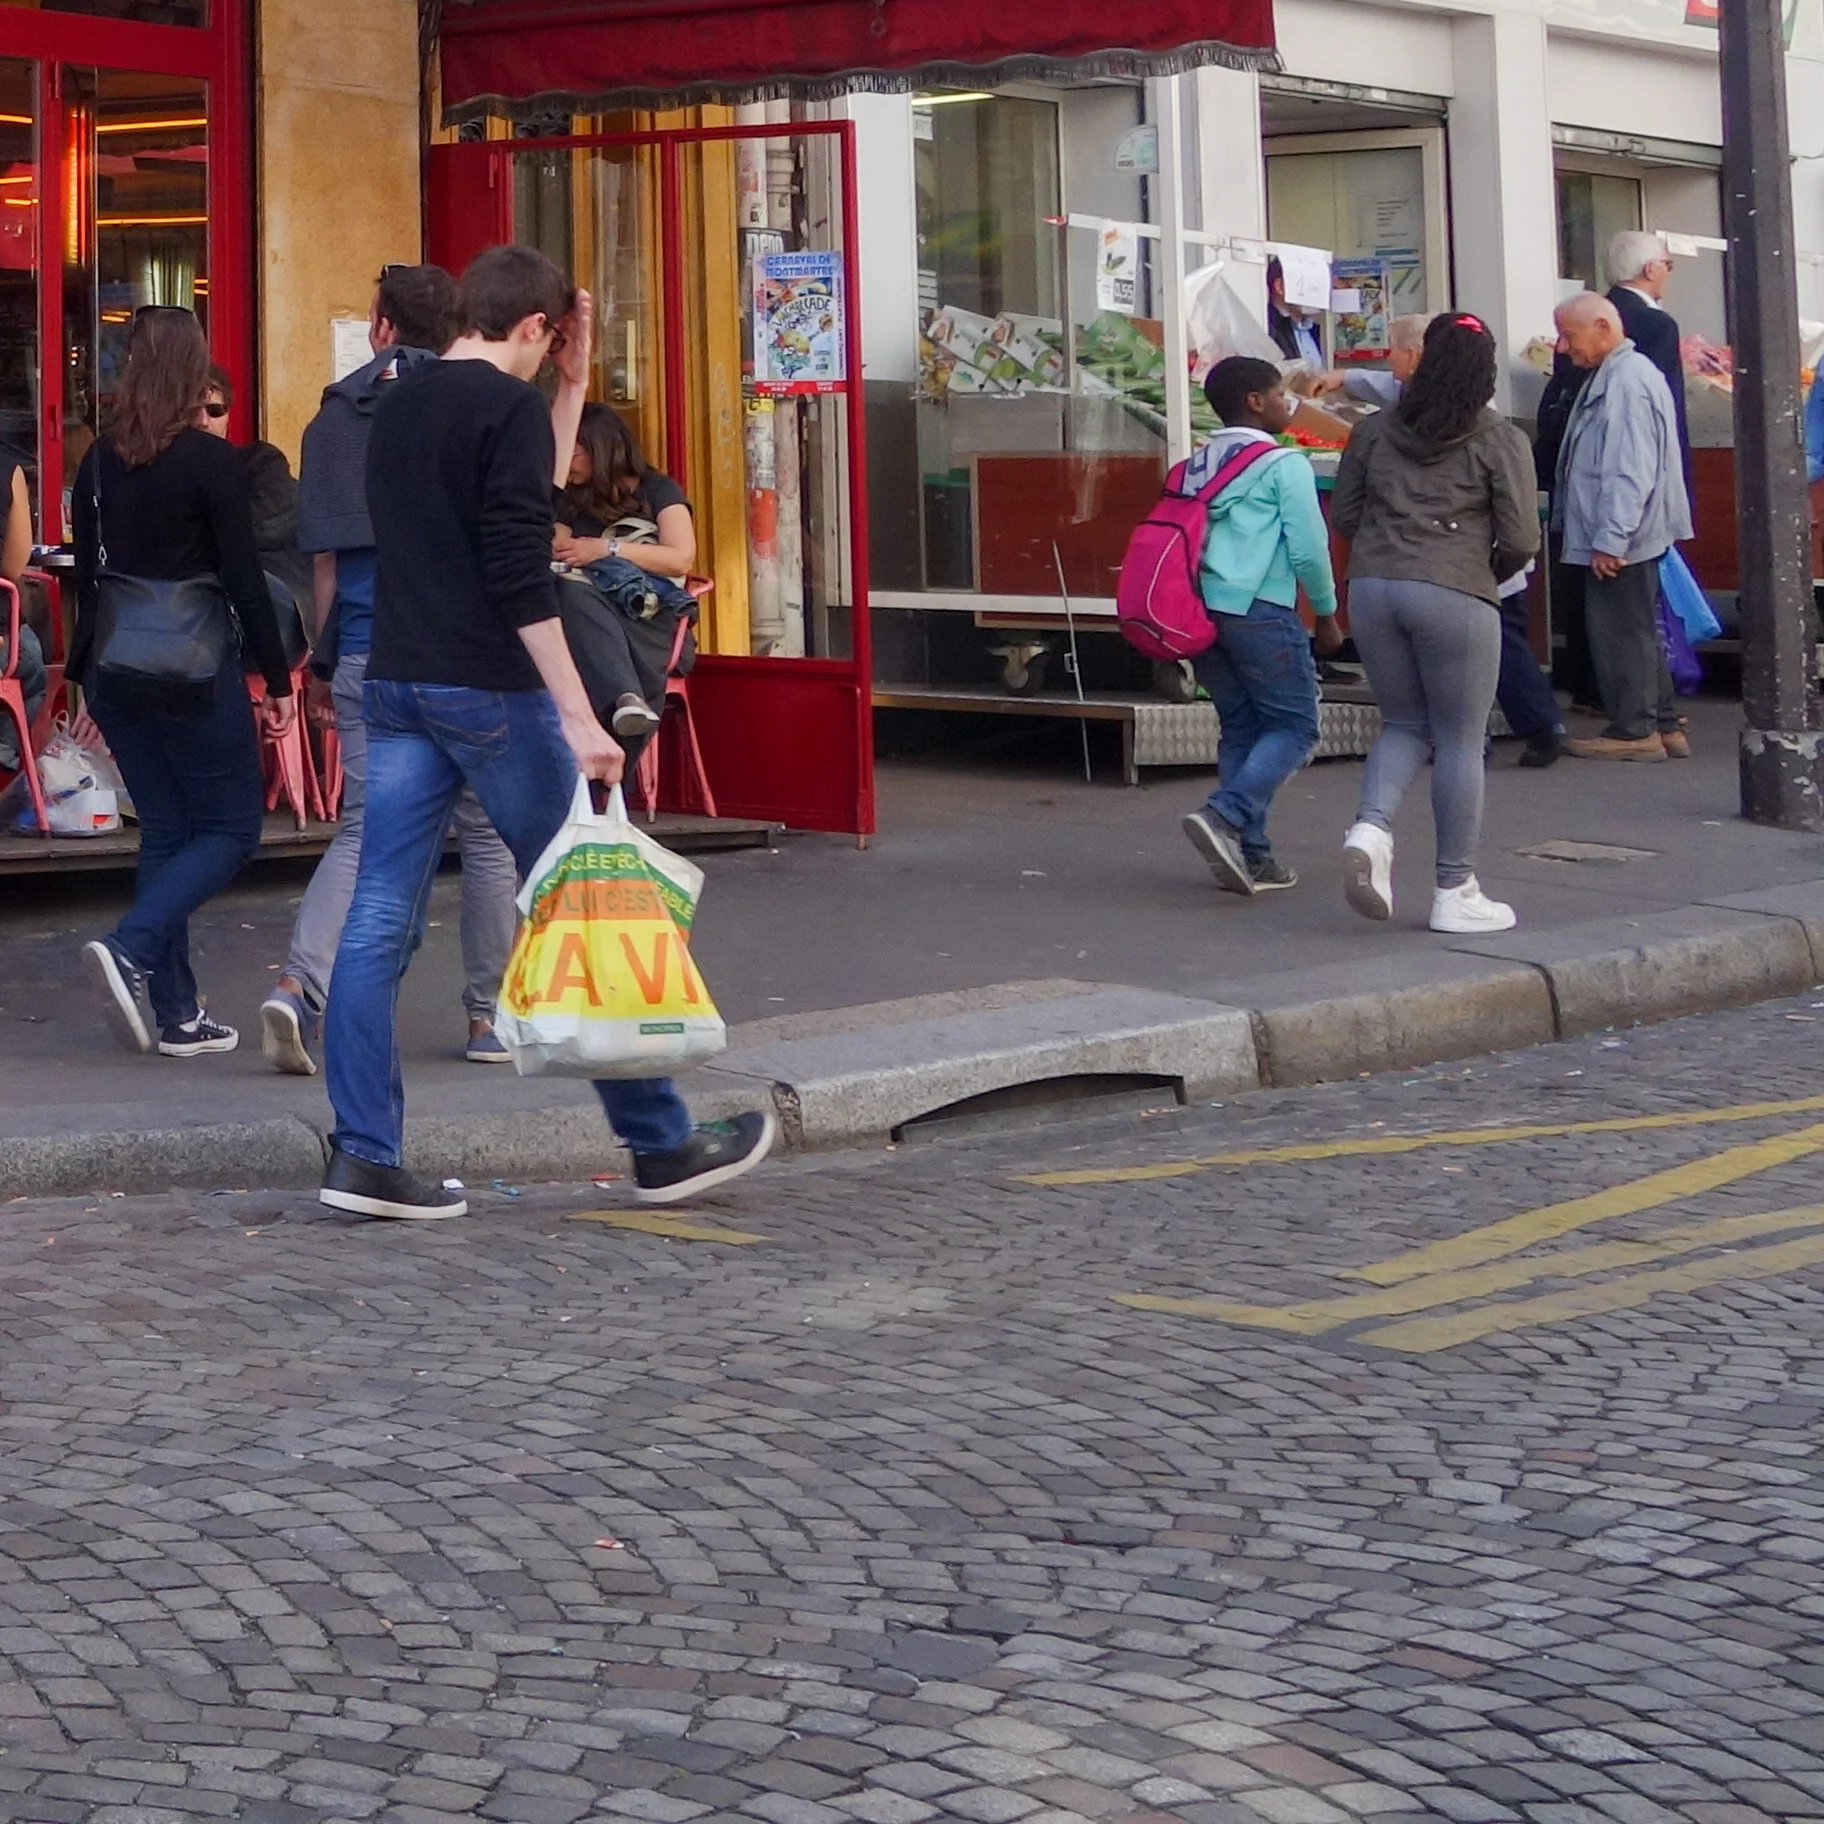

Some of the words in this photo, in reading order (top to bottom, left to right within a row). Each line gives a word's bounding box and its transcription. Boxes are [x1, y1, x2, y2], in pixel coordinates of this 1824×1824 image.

[767, 255, 817, 266] CARNAVAL
[819, 255, 831, 265] DE
[765, 266, 834, 277] MONTMARTRE
